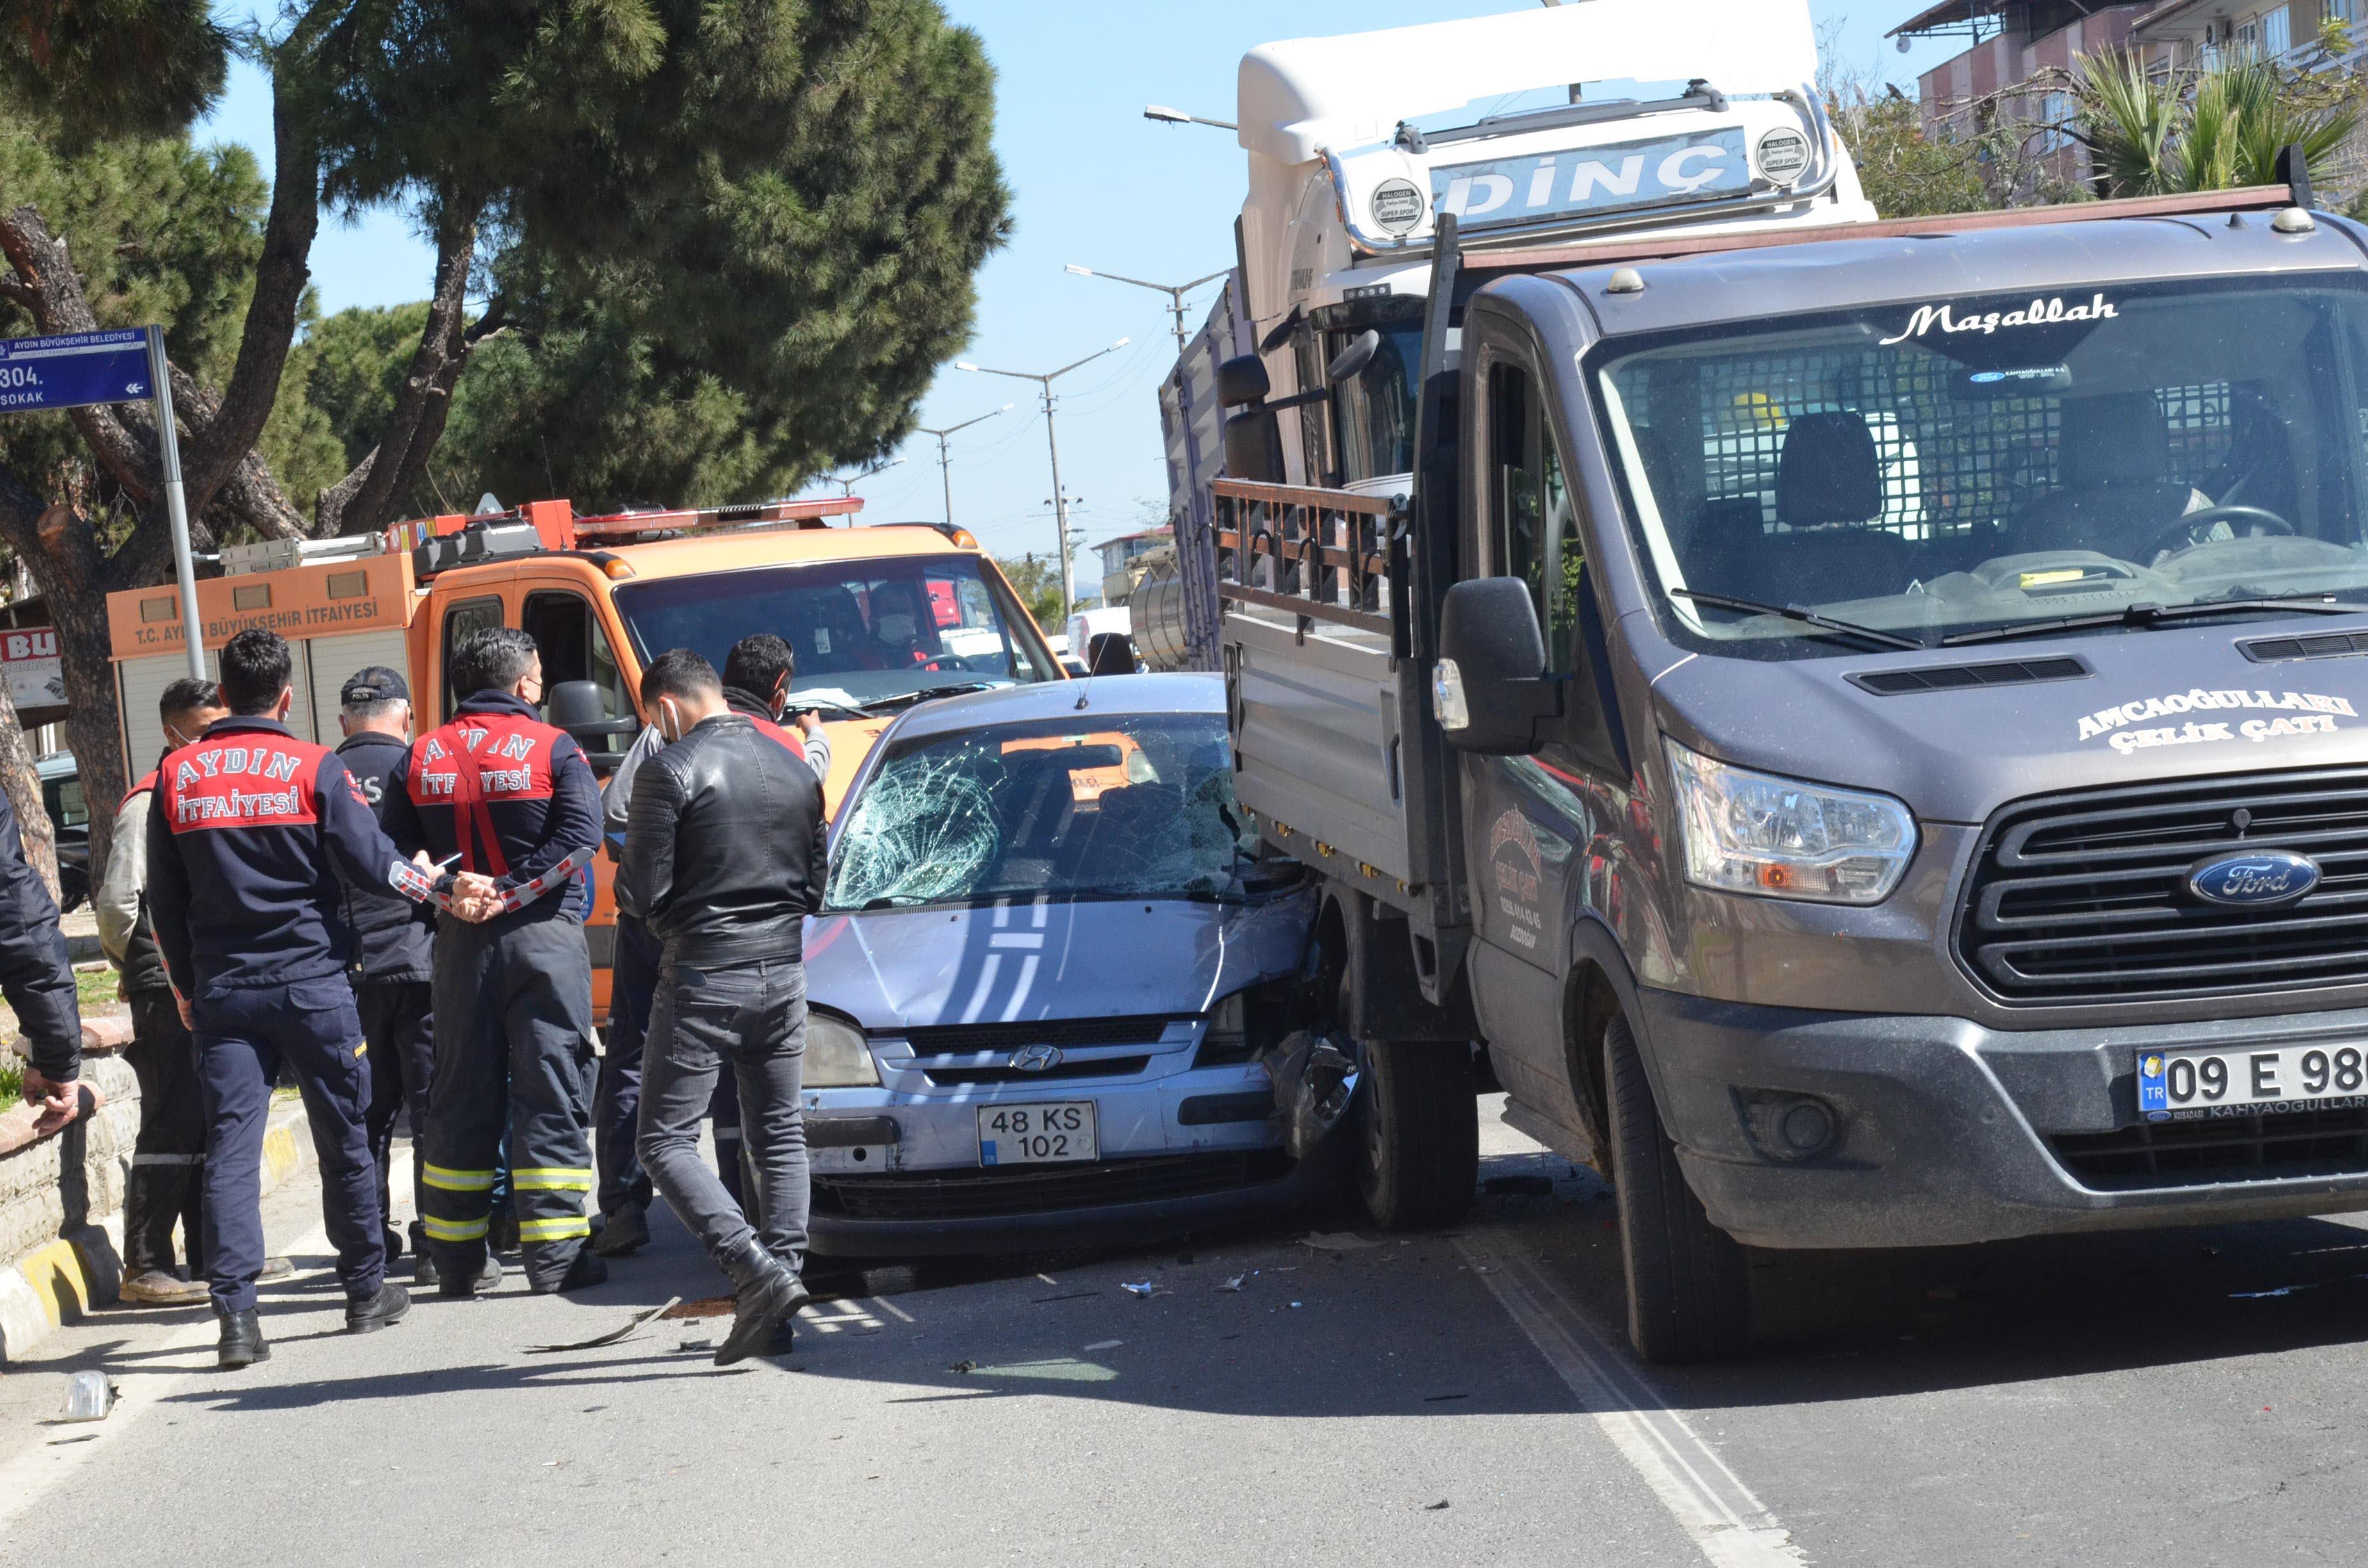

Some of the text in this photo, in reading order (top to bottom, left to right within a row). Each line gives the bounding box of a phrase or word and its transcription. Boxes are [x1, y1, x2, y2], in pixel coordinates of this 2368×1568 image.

[1766, 137, 1797, 148] HALOGEN
[1765, 156, 1802, 167] SUPER SPORT
[1381, 190, 1411, 199] HALOGEN
[1444, 145, 1728, 216] DİNÇ
[1879, 293, 2119, 345] Maşallah
[14, 331, 135, 350] AYDIN BÜYÜKŞEHİR BELEDİYESİ
[0, 391, 44, 405] SOKAK
[136, 626, 160, 644] T.C.
[306, 596, 379, 625] İTFAİYESİ
[2077, 689, 2359, 742] AMCAOĞULLARI
[2109, 714, 2339, 756] ÇELİK ÇATI
[176, 748, 302, 791] AYDIN
[421, 763, 532, 796] İTFYESİ
[177, 785, 300, 824] İTFAİYESİ
[2222, 863, 2291, 895] Ford
[2167, 1046, 2368, 1103] 09 E 98
[2146, 1087, 2164, 1100] TR
[991, 1107, 1081, 1134] 48 KS
[985, 1155, 996, 1166] TR
[1018, 1134, 1069, 1157] 102
